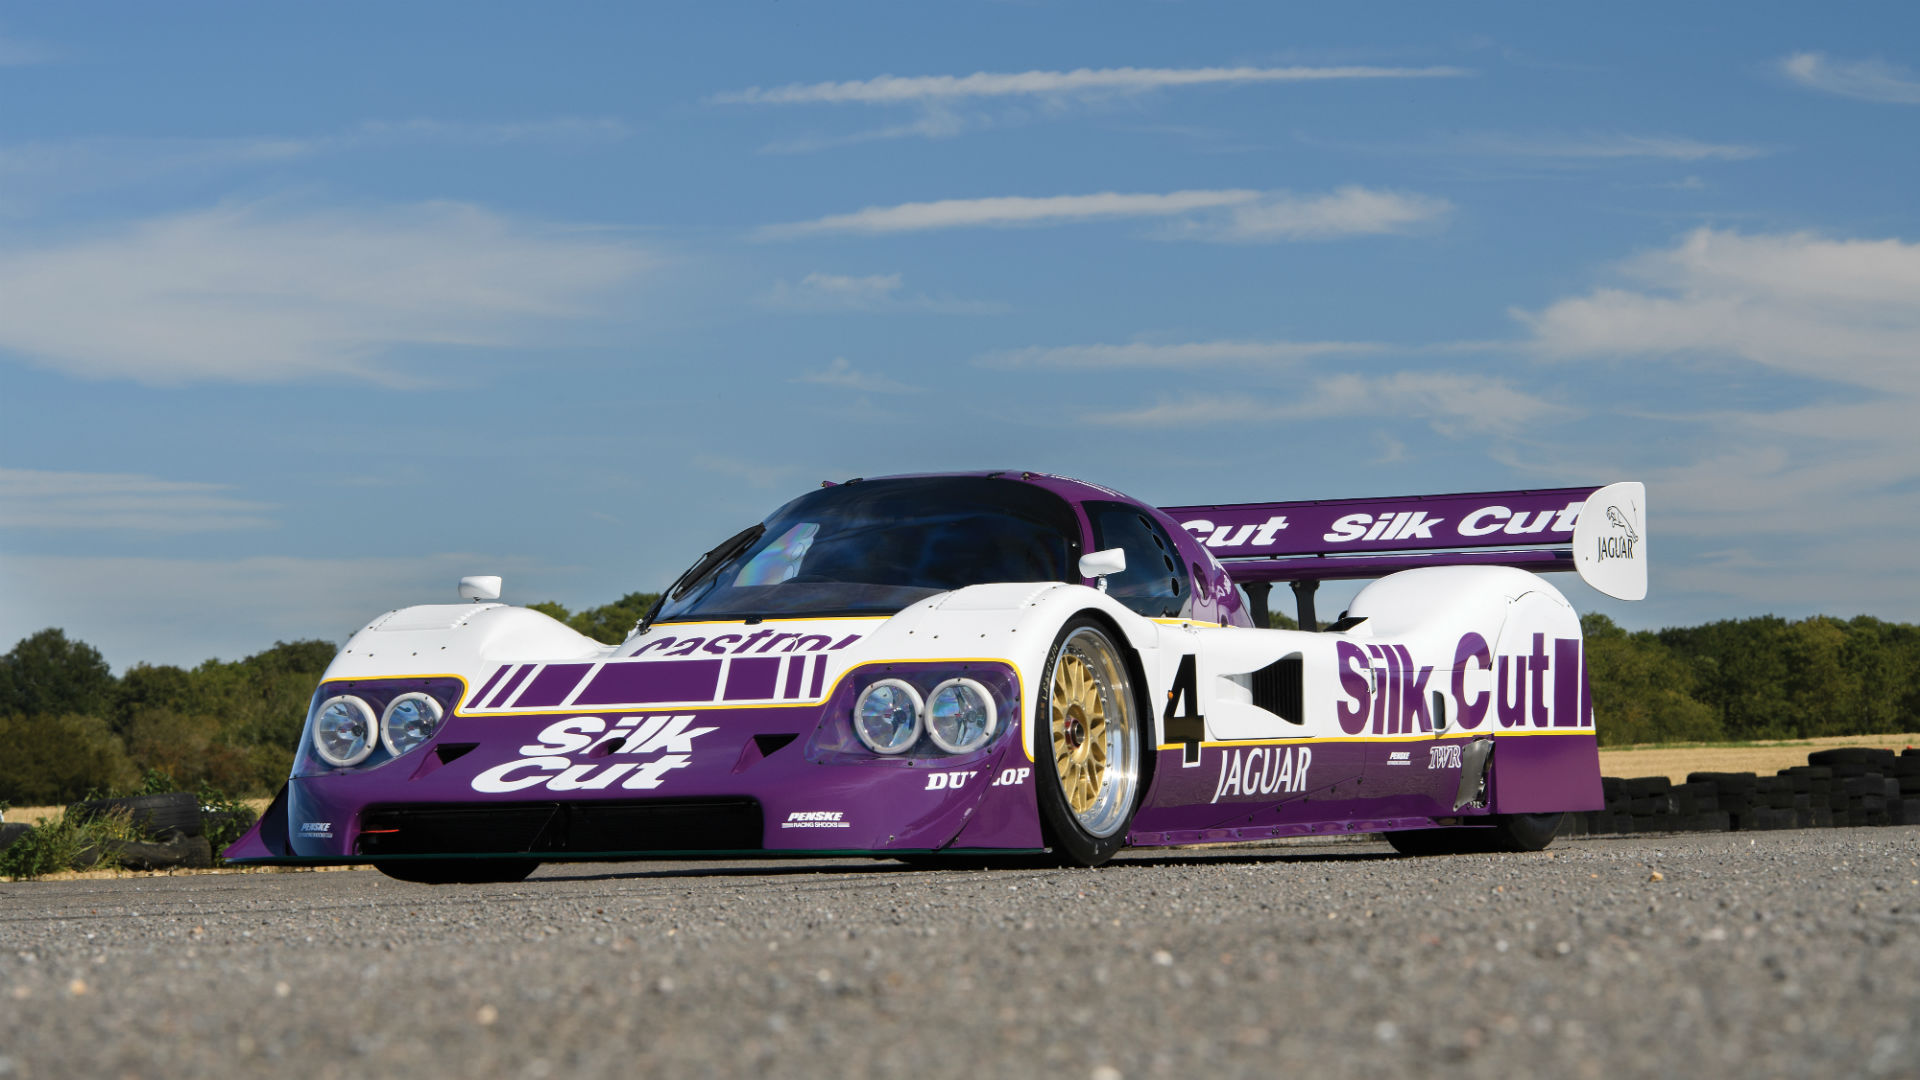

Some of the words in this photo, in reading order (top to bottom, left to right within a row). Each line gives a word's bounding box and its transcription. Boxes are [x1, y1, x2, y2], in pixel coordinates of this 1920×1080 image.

[1180, 515, 1290, 547] Cut
[1322, 510, 1446, 543] Silk
[1456, 504, 1589, 537] Cut
[1597, 536, 1634, 563] JAGUAR
[1335, 640, 1435, 736] Silk
[1451, 631, 1550, 730] Cut
[1163, 653, 1205, 764] 4
[518, 714, 721, 757] Silk
[470, 754, 693, 794] Cut
[1427, 744, 1462, 769] TWR
[924, 767, 1031, 791] DUOP
[1210, 746, 1313, 804] JAGUAR
[301, 822, 332, 832] PENSKE
[787, 811, 844, 822] PENSKE
